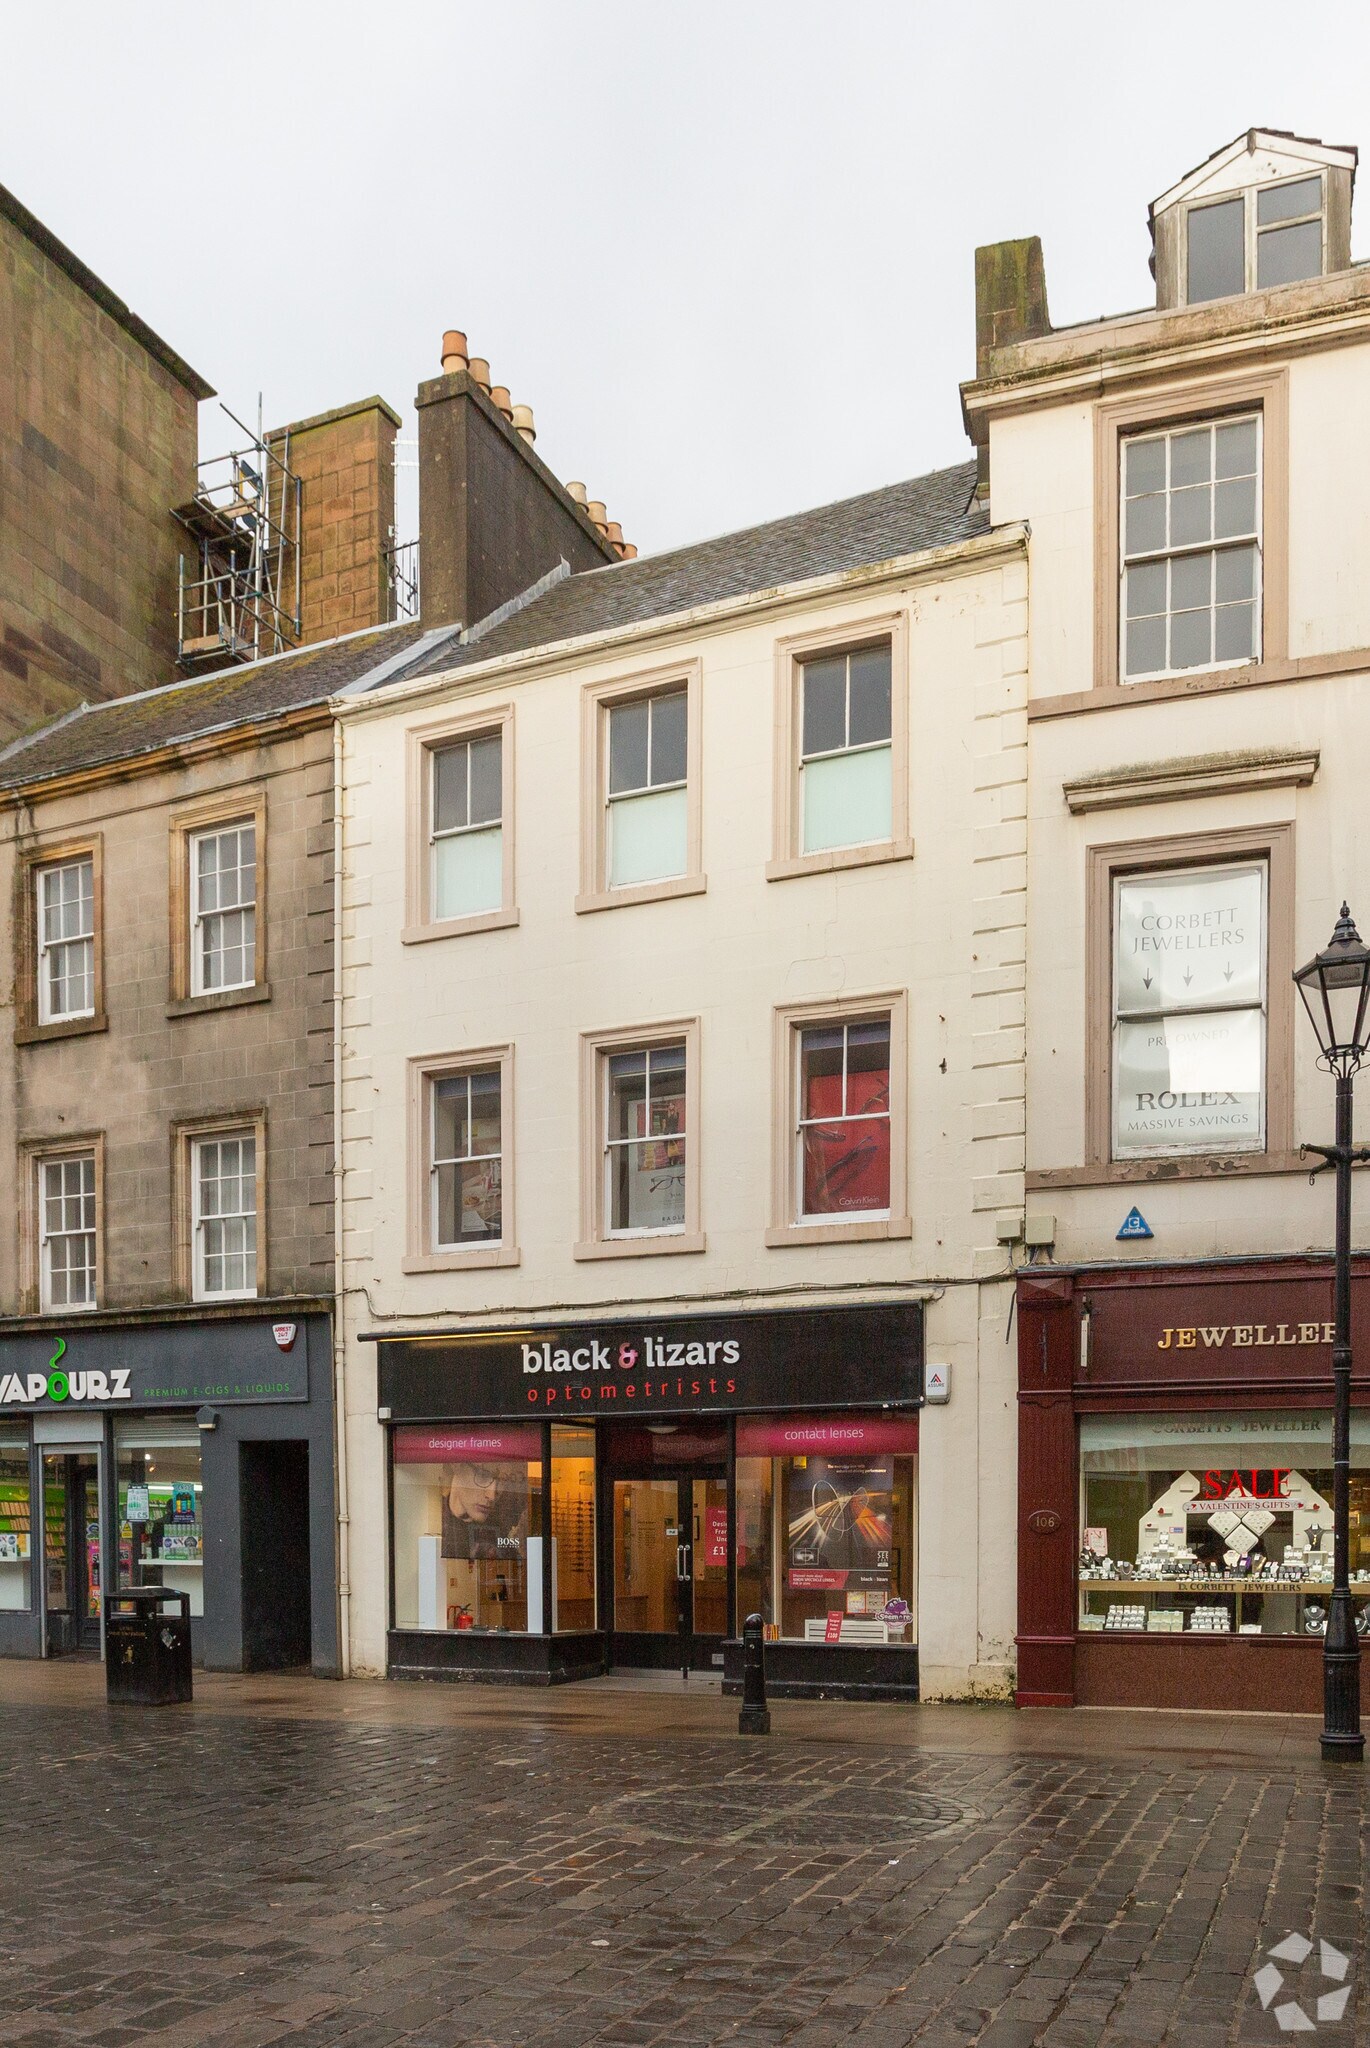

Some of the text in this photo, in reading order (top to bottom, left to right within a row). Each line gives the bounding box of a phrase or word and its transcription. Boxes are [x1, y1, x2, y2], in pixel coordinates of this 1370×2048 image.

[1141, 907, 1239, 931] CORBETT
[1132, 928, 1245, 955] JEWELLERS
[1135, 1091, 1242, 1112] ROLEX
[1127, 1113, 1249, 1132] MASSIVE SAVINGS
[521, 1336, 740, 1373] black & lizars
[144, 1387, 188, 1396] PREMIUM
[234, 1386, 241, 1394] &
[246, 1383, 290, 1393] LIQUIDS
[527, 1378, 736, 1405] optometrists
[784, 1427, 864, 1440] contact lenses
[1152, 1423, 1232, 1434] CORBETTS
[428, 1437, 502, 1450] designer frames
[1204, 1469, 1292, 1500] SALE
[1199, 1501, 1290, 1511] VALENTINE'S GIFTS
[1036, 1517, 1055, 1528] 106
[497, 1537, 520, 1546] BOSS
[1190, 1583, 1236, 1591] CORBETT
[1243, 1584, 1301, 1592] JEWELLERS
